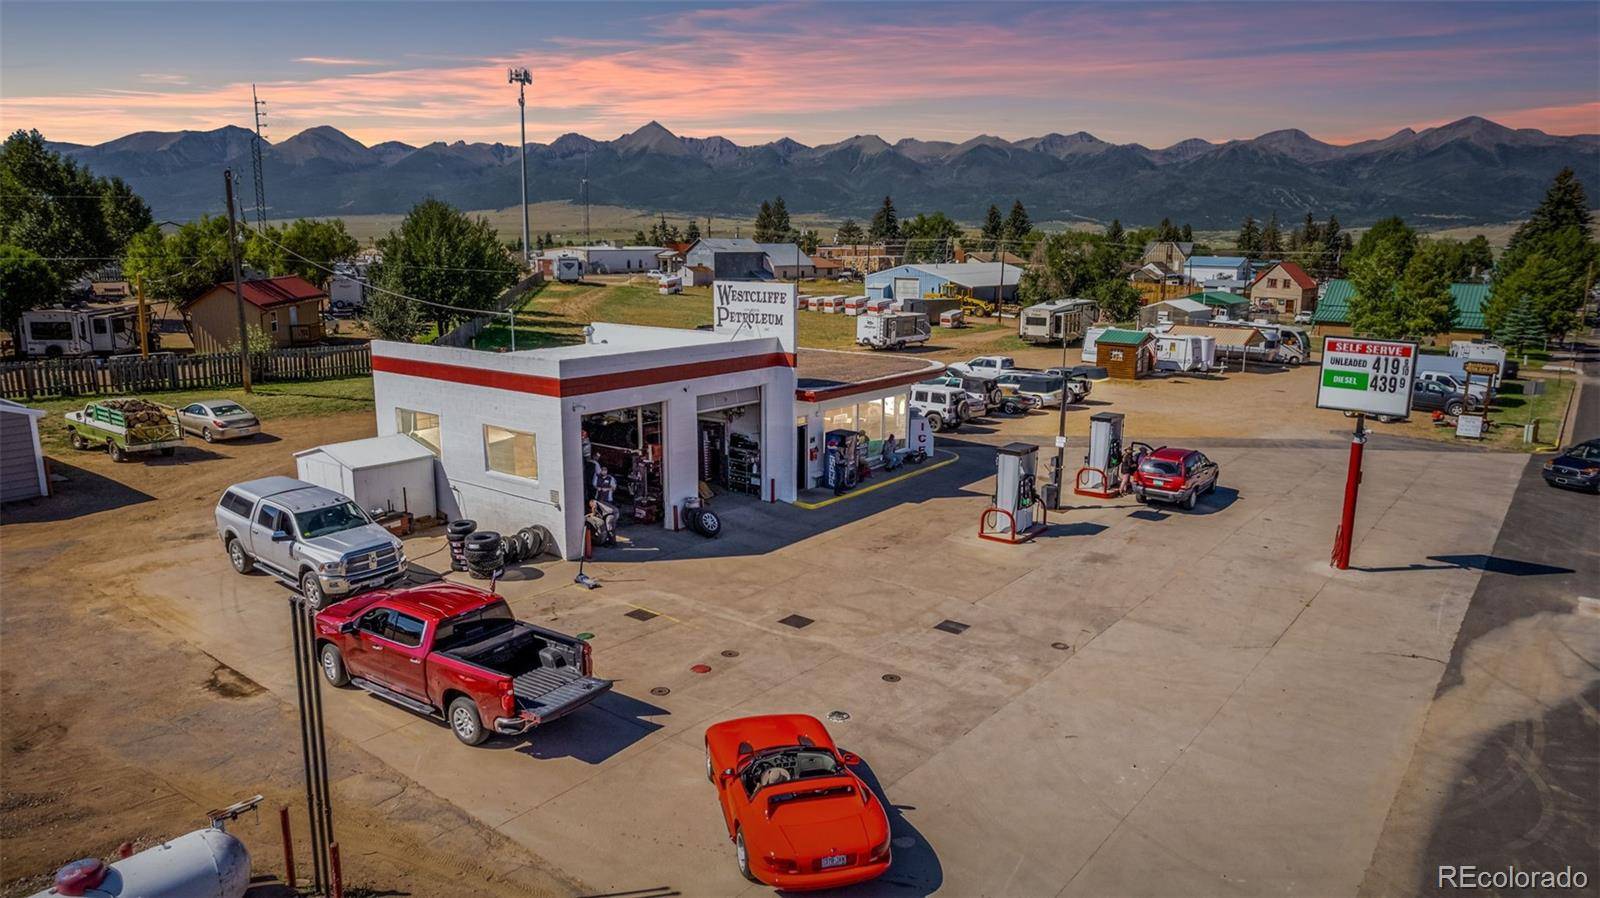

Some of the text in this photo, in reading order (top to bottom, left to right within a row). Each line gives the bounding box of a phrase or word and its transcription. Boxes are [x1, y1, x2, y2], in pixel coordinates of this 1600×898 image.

[717, 284, 787, 305] WESTCLIFFE
[716, 307, 784, 327] PETROLEUM
[1336, 342, 1403, 356] SELF SERVE
[1330, 356, 1400, 375] UNLEADED 419
[1333, 375, 1358, 385] DIESEL
[1370, 375, 1397, 393] 439
